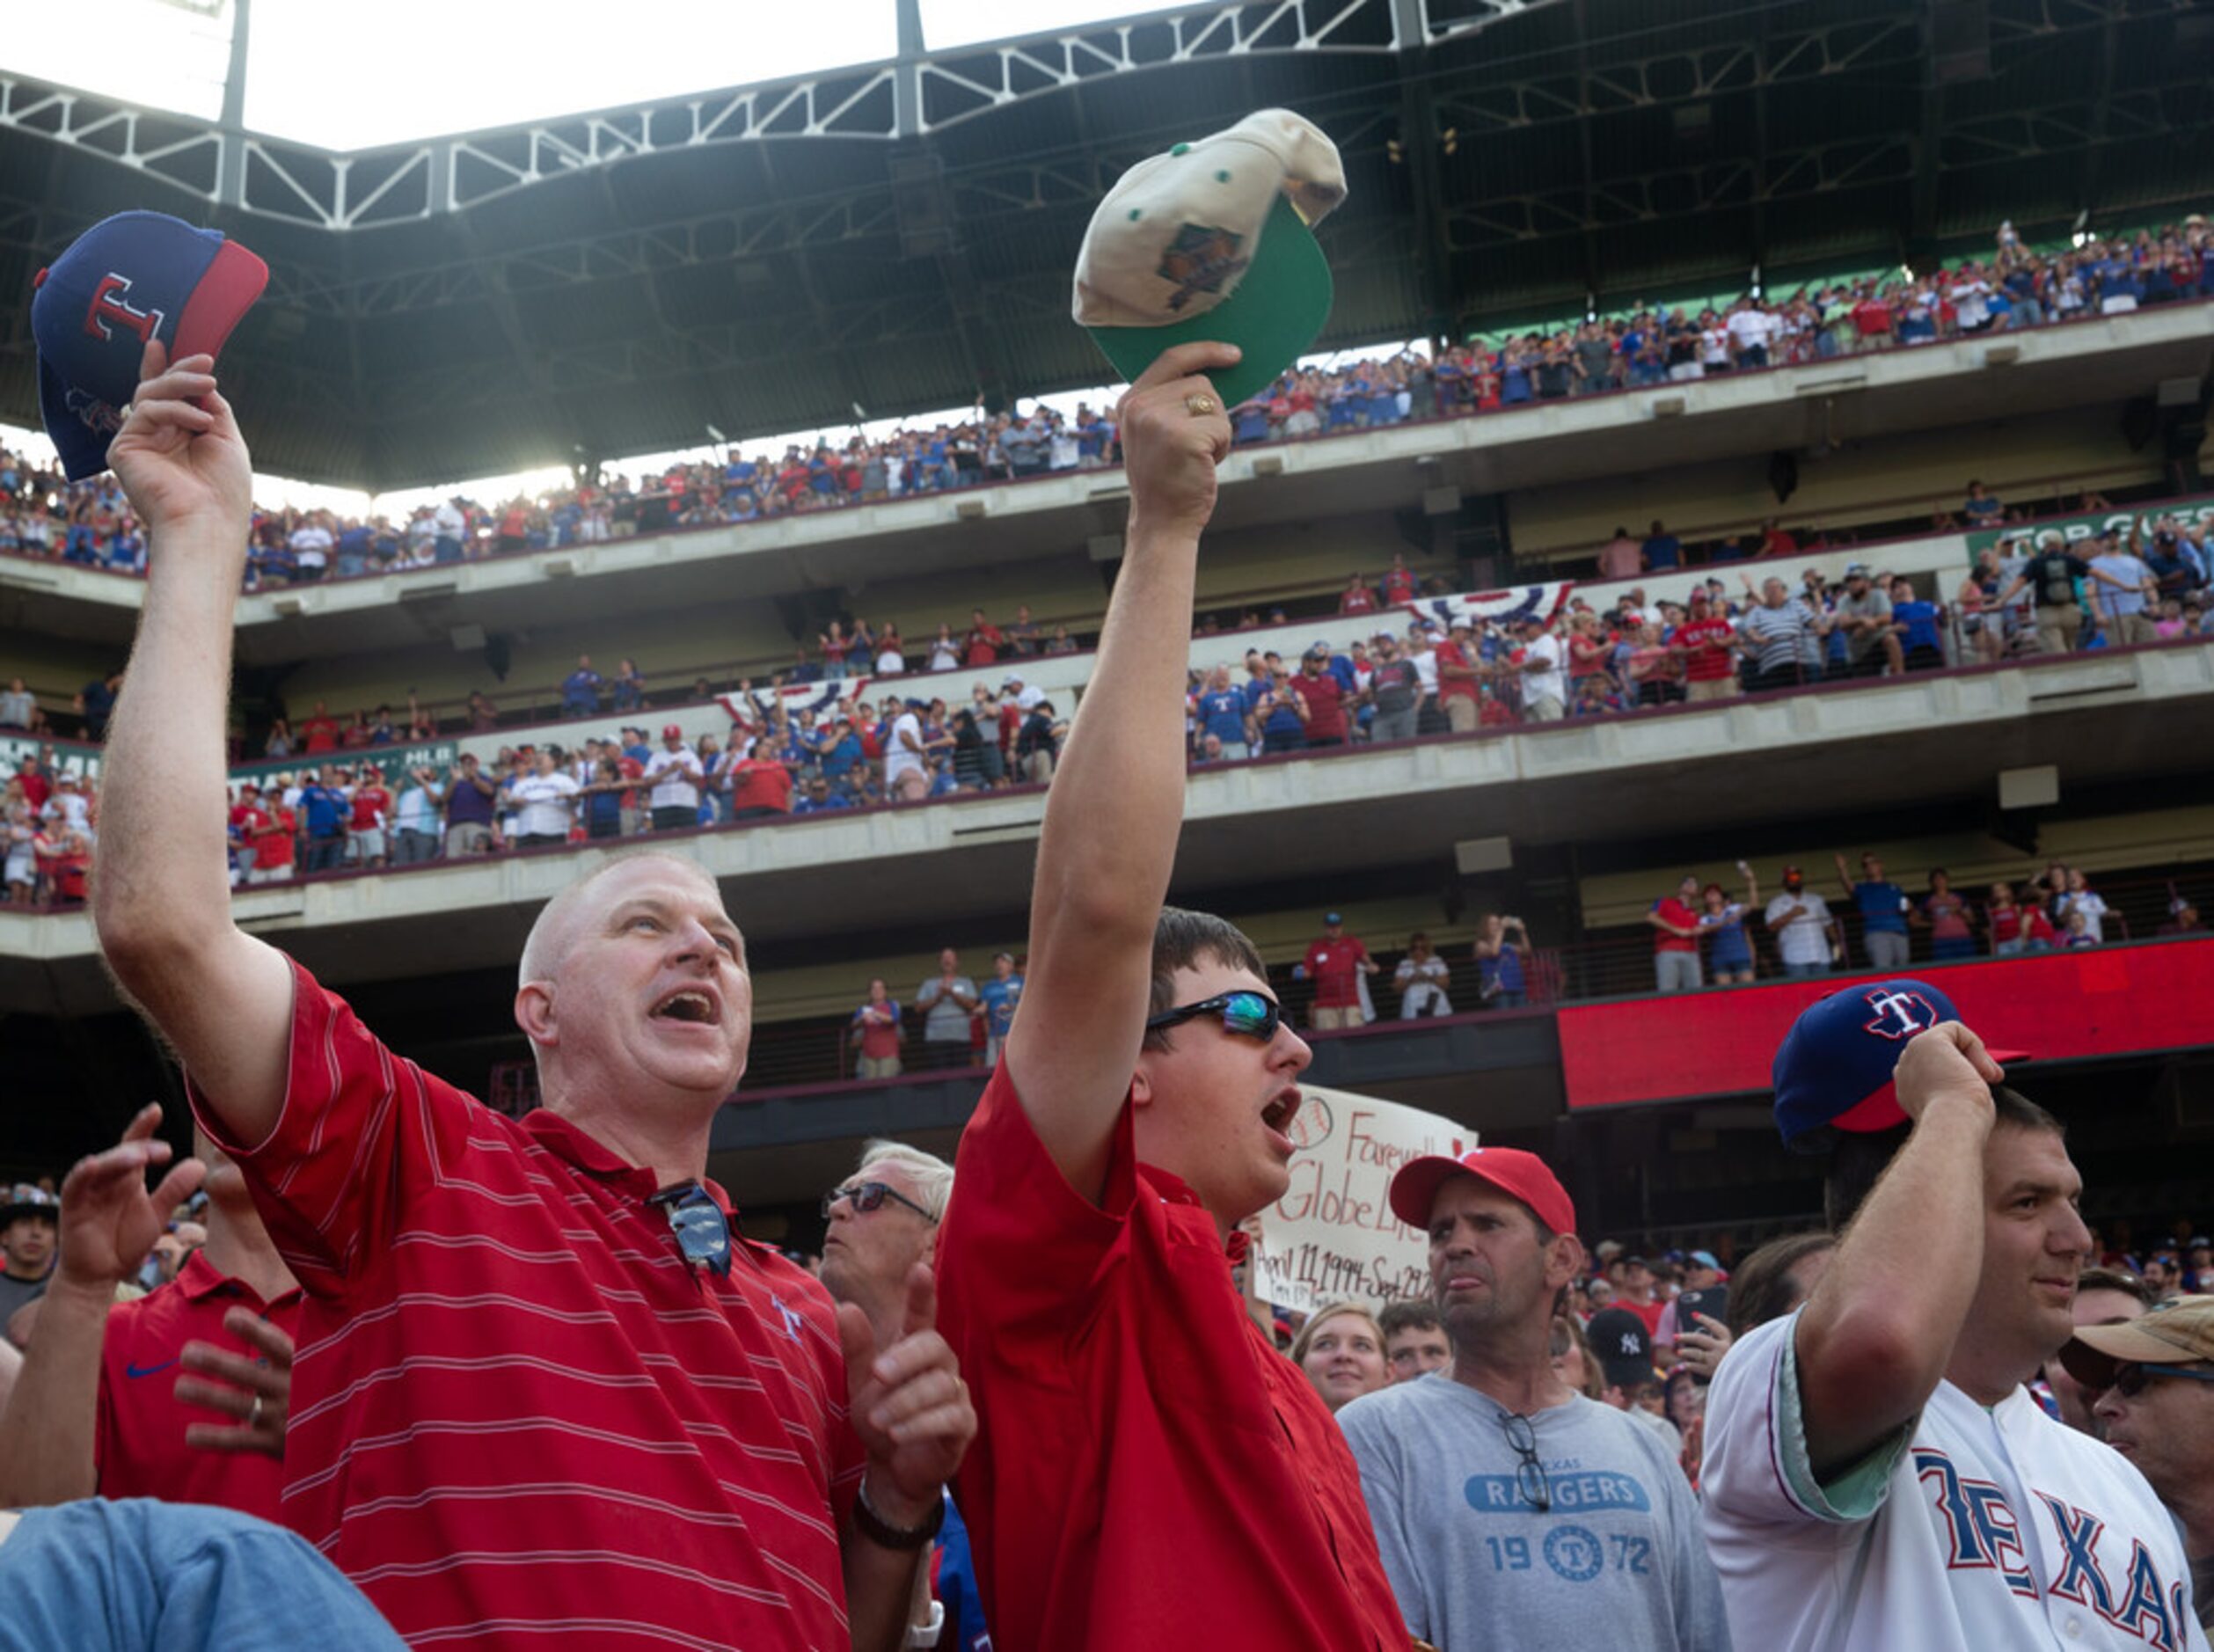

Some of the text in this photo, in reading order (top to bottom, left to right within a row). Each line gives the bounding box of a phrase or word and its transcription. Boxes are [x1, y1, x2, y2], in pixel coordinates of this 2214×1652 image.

[84, 271, 165, 344] T
[1872, 991, 1920, 1034] T
[1275, 1159, 1372, 1225] Globe
[1540, 1457, 1582, 1472] EXAS
[1486, 1535, 1532, 1572] 19
[1609, 1534, 1651, 1575] 72
